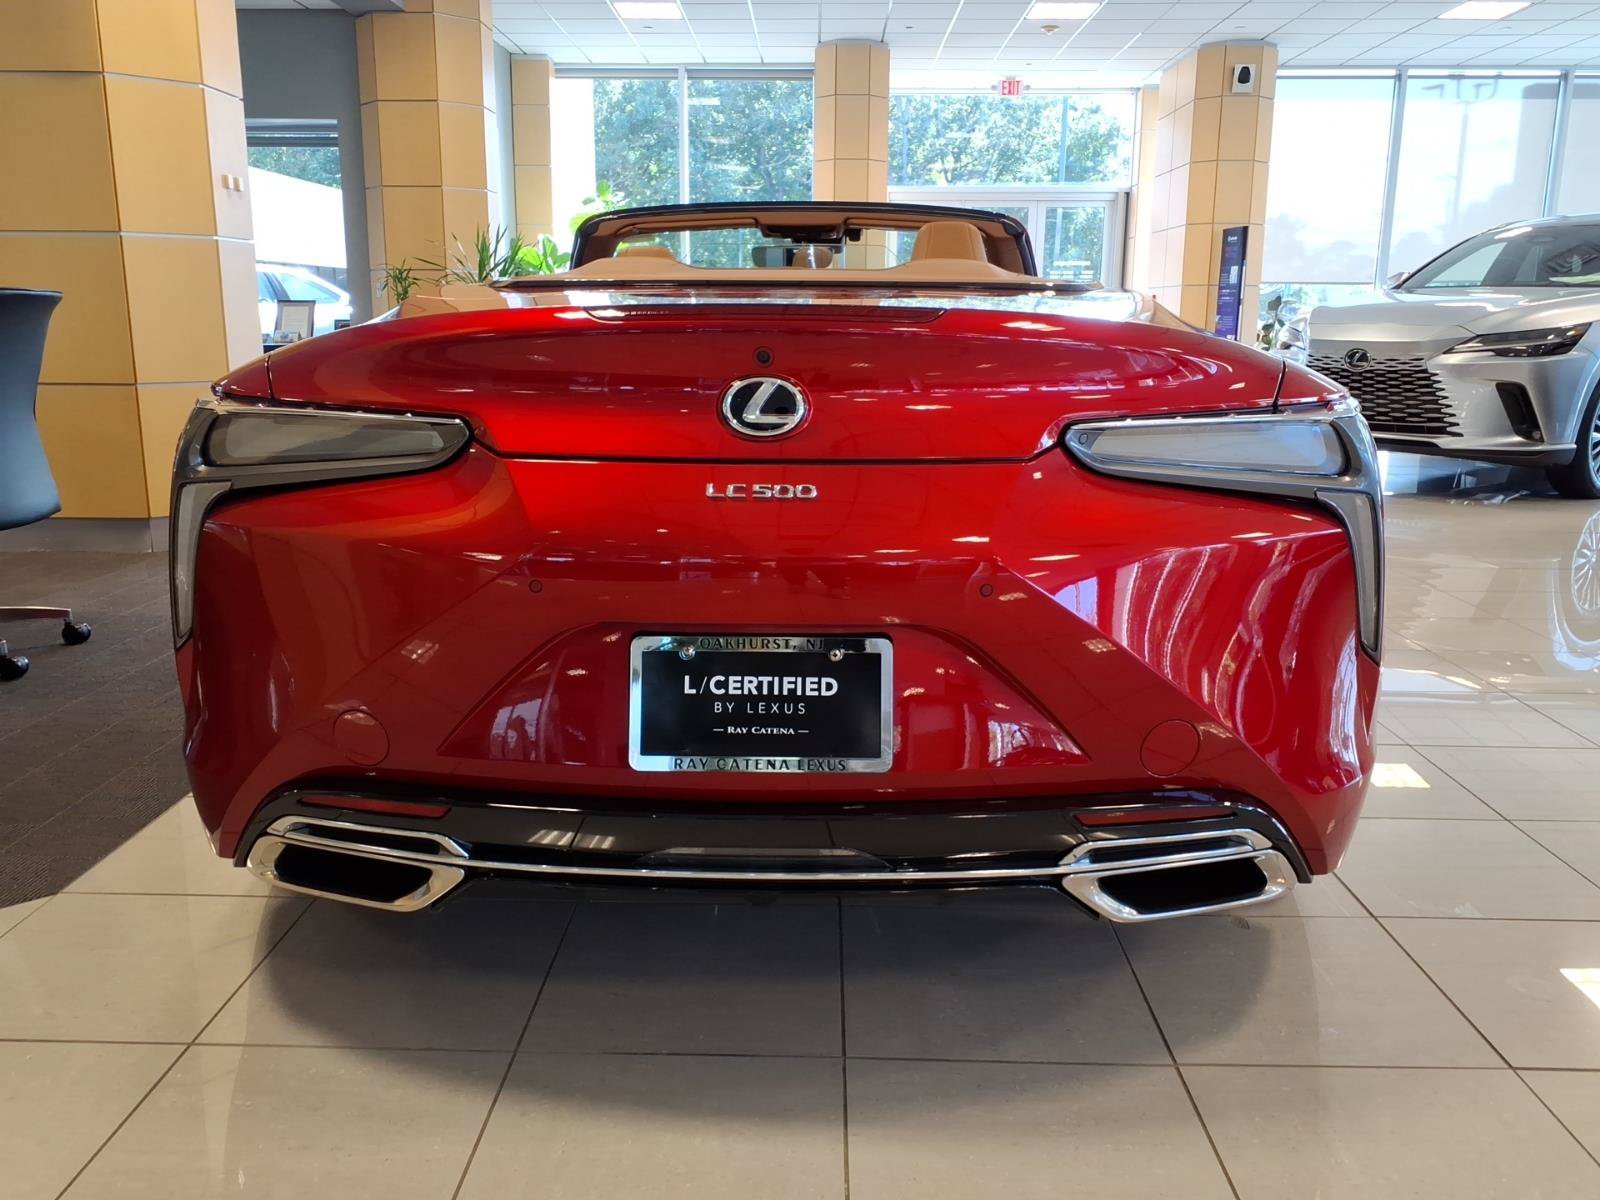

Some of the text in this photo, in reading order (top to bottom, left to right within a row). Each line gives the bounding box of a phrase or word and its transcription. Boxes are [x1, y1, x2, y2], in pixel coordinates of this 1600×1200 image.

[1001, 80, 1020, 96] EXIT
[706, 483, 817, 499] LC 500
[700, 638, 824, 650] OAKHURST, NJ
[684, 675, 838, 696] L/CERTIFIED
[714, 702, 806, 714] BY LEXUS
[673, 757, 847, 771] RAY CATENA LEXUS
